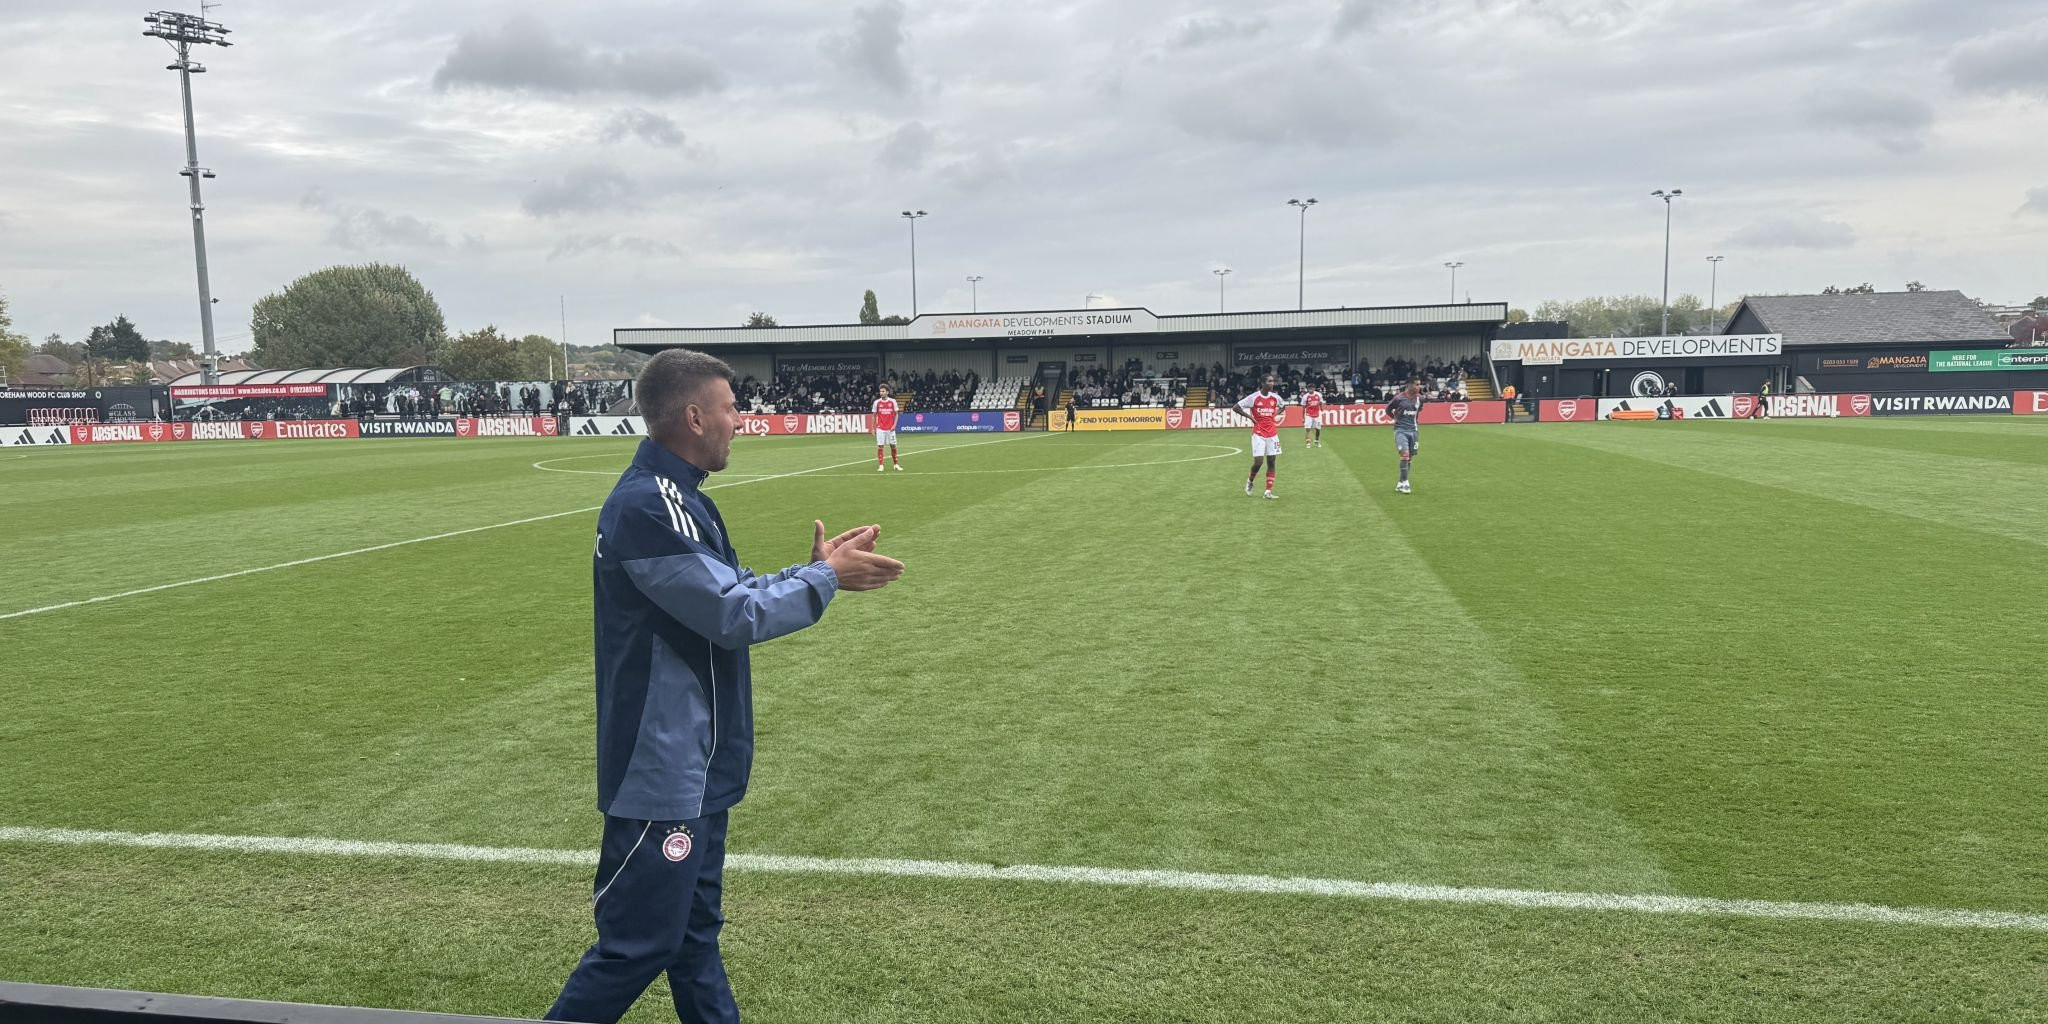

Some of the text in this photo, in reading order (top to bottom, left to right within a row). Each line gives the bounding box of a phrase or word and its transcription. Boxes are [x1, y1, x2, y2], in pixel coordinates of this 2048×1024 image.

[949, 314, 1132, 329] MANGATA DEVELOPMENTS STADIUM
[1038, 328, 1055, 336] PARK
[1518, 337, 1778, 358] MANGATA DEVELOPMENTS
[1880, 355, 1927, 365] MANGATA
[27, 391, 47, 399] WOOD
[48, 391, 55, 399] FC
[57, 391, 71, 399] CLUB
[71, 391, 87, 399] SHOP
[1872, 395, 2011, 411] VISIT RWANDA
[1762, 394, 1841, 417] ARSENAL
[477, 417, 536, 436] ARSENAL
[805, 414, 870, 434] ARSENAL
[1119, 415, 1163, 423] TOMORROW
[92, 425, 143, 442] ARSENAL
[191, 421, 245, 440] ARSENAL
[275, 420, 347, 438] Emirates
[359, 421, 455, 434] VISIT RWANDA
